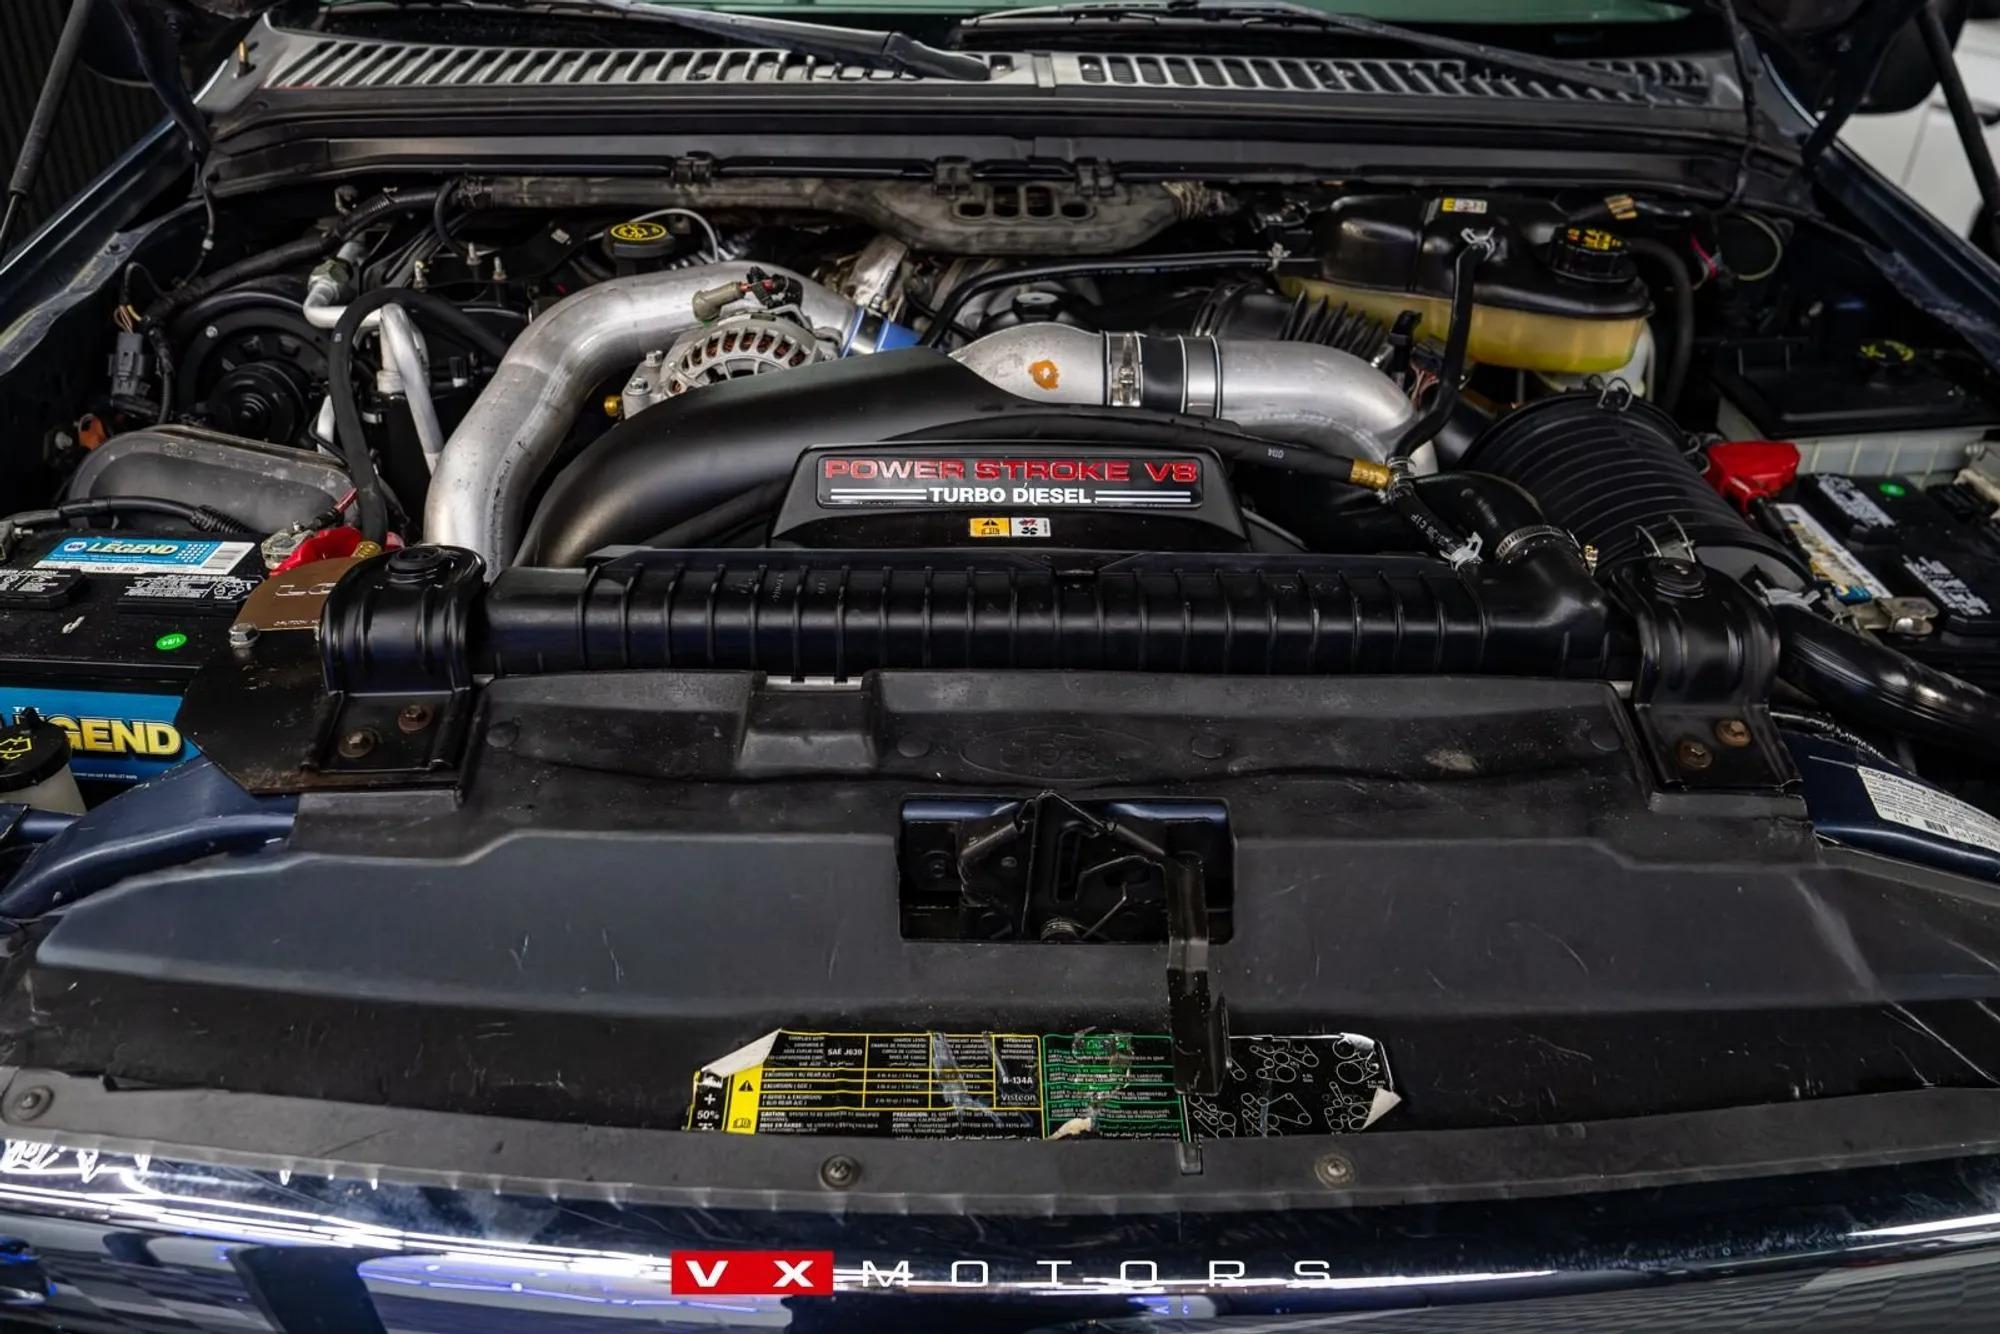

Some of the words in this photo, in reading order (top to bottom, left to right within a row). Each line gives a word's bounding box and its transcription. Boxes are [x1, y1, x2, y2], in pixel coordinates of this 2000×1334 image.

[824, 459, 964, 481] POWER
[974, 459, 1131, 482] STROKE
[1144, 462, 1198, 482] V8
[929, 487, 1006, 503] TURBO
[1013, 487, 1092, 504] DIESEL
[86, 542, 179, 555] LEGEND
[827, 1048, 842, 1056] SAE
[1002, 1076, 1033, 1084] R-134A
